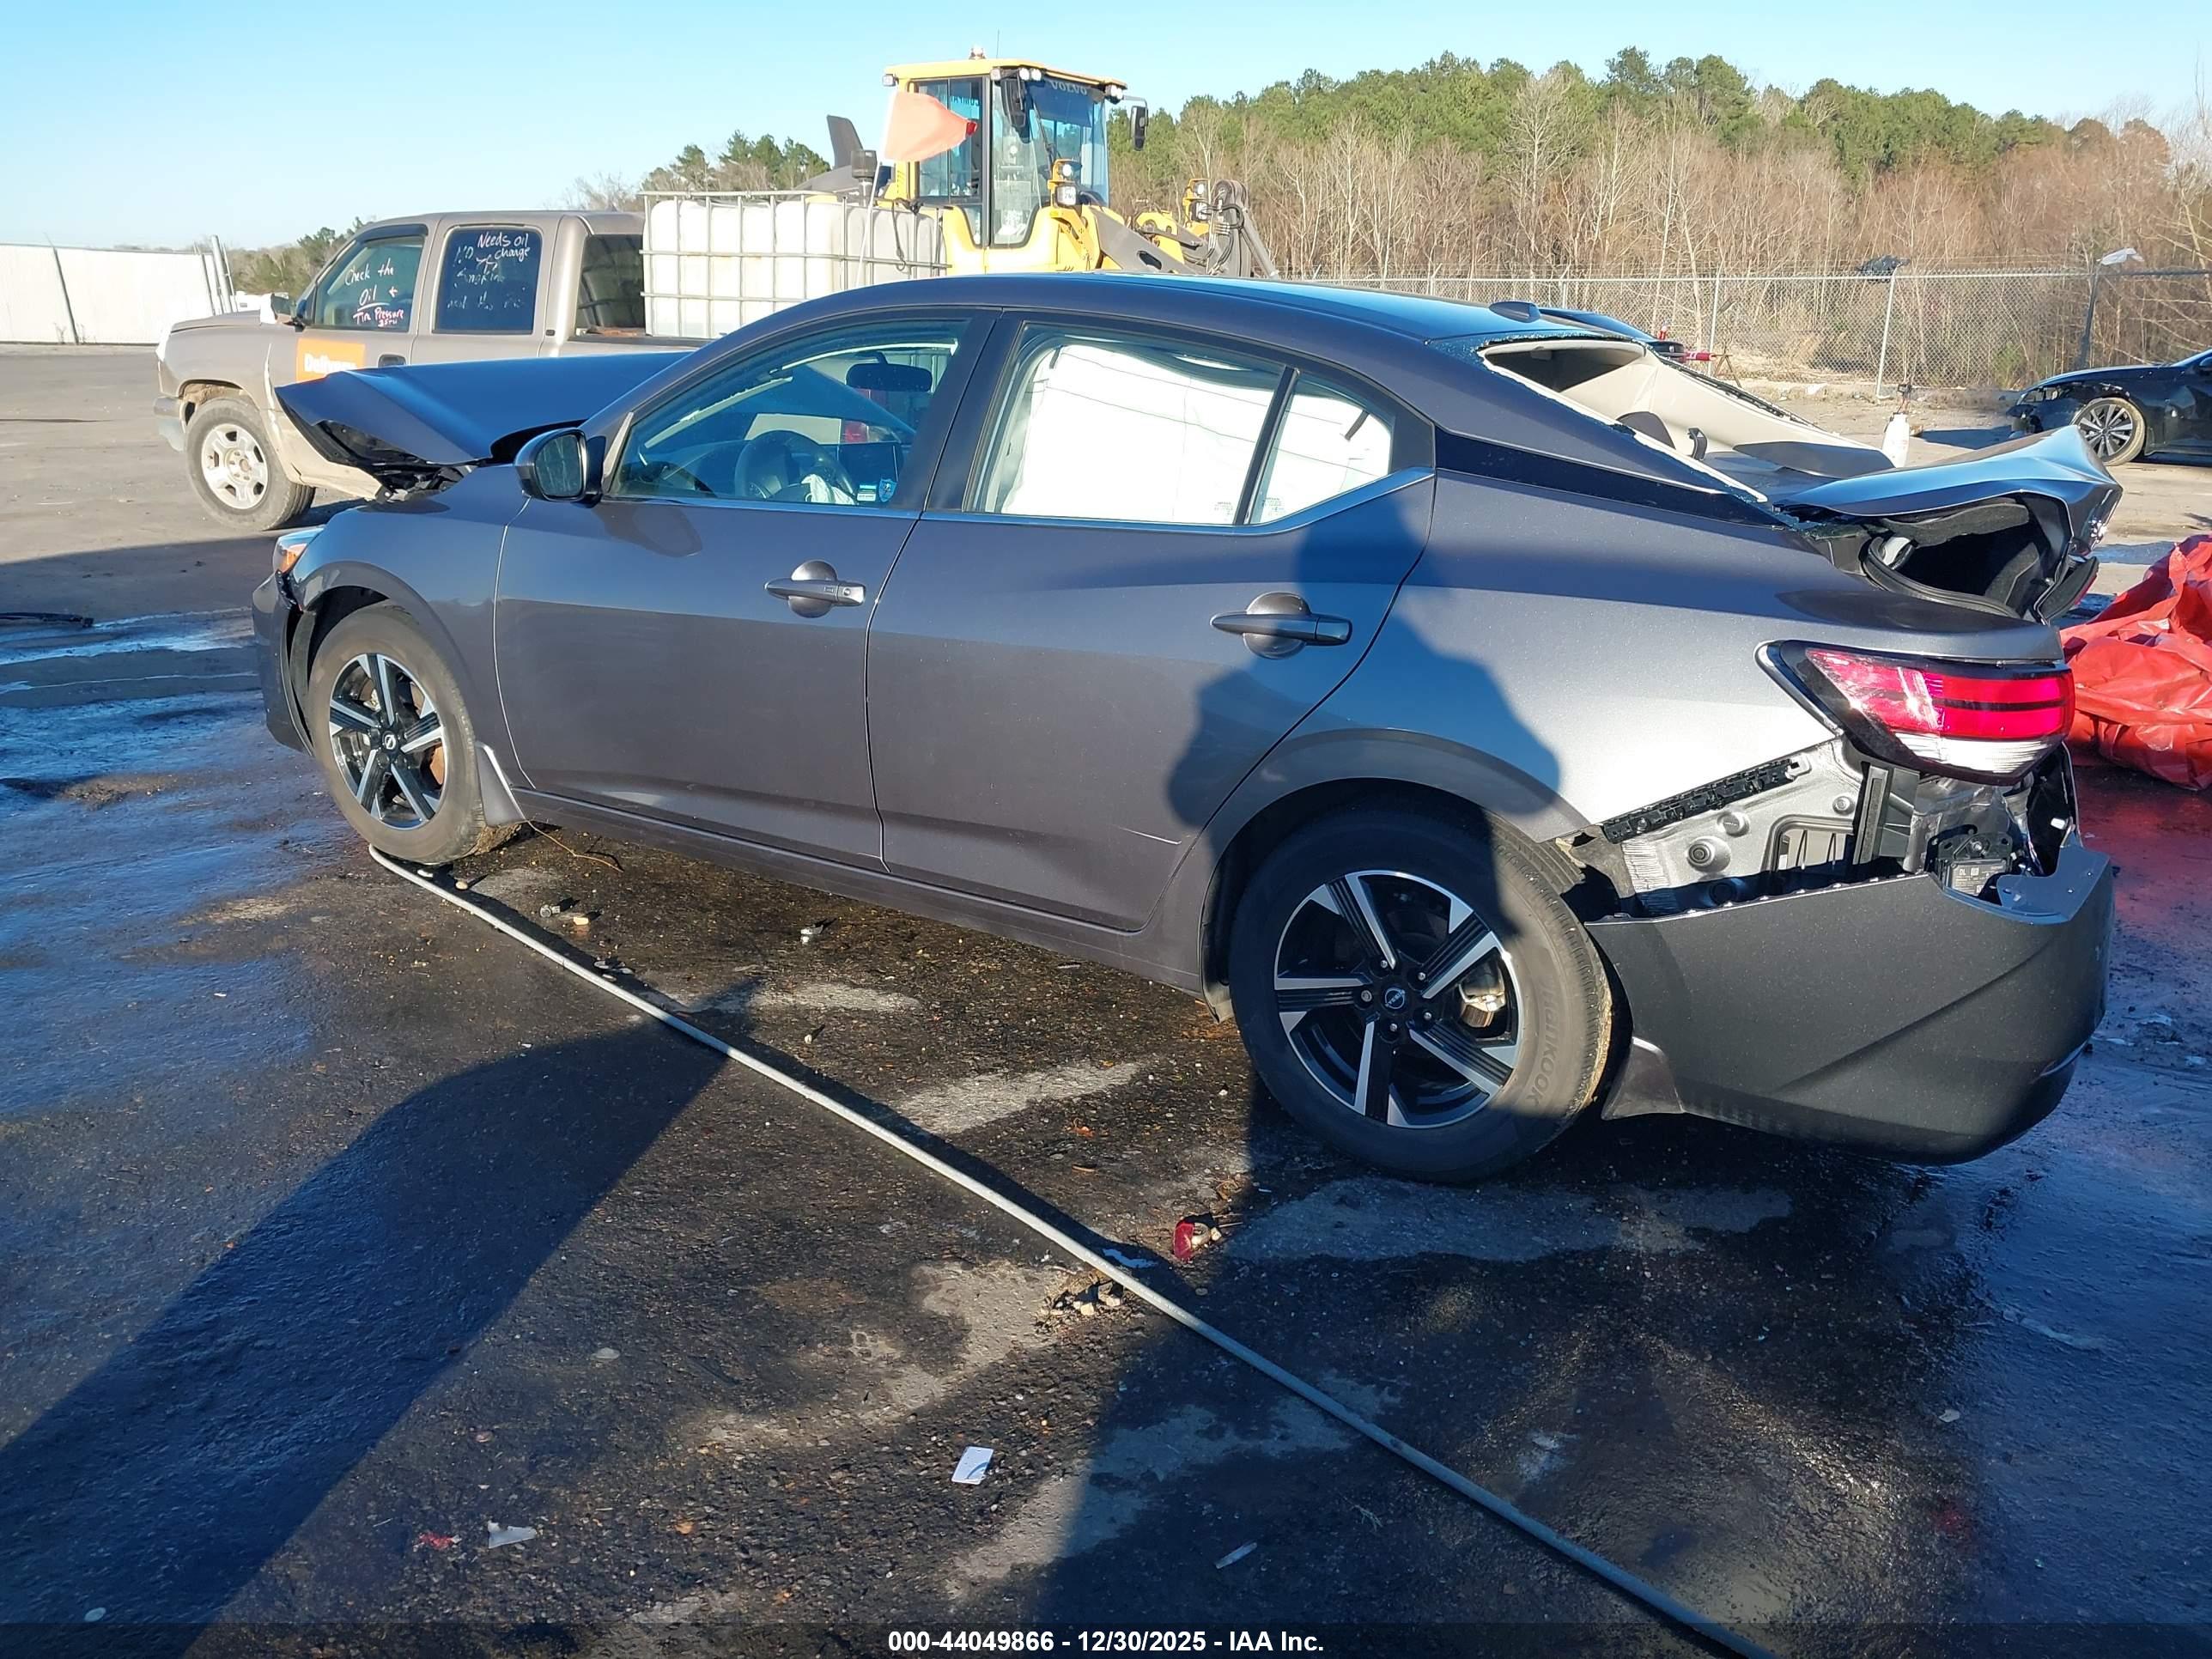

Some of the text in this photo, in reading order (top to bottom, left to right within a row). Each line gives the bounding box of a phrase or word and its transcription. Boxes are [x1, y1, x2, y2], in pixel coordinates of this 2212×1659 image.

[1050, 80, 1088, 95] VOLVO
[477, 231, 511, 248] Needs
[495, 247, 531, 262] change
[345, 258, 394, 286] Check the
[359, 284, 377, 306] Oil
[374, 307, 404, 321] Pressure
